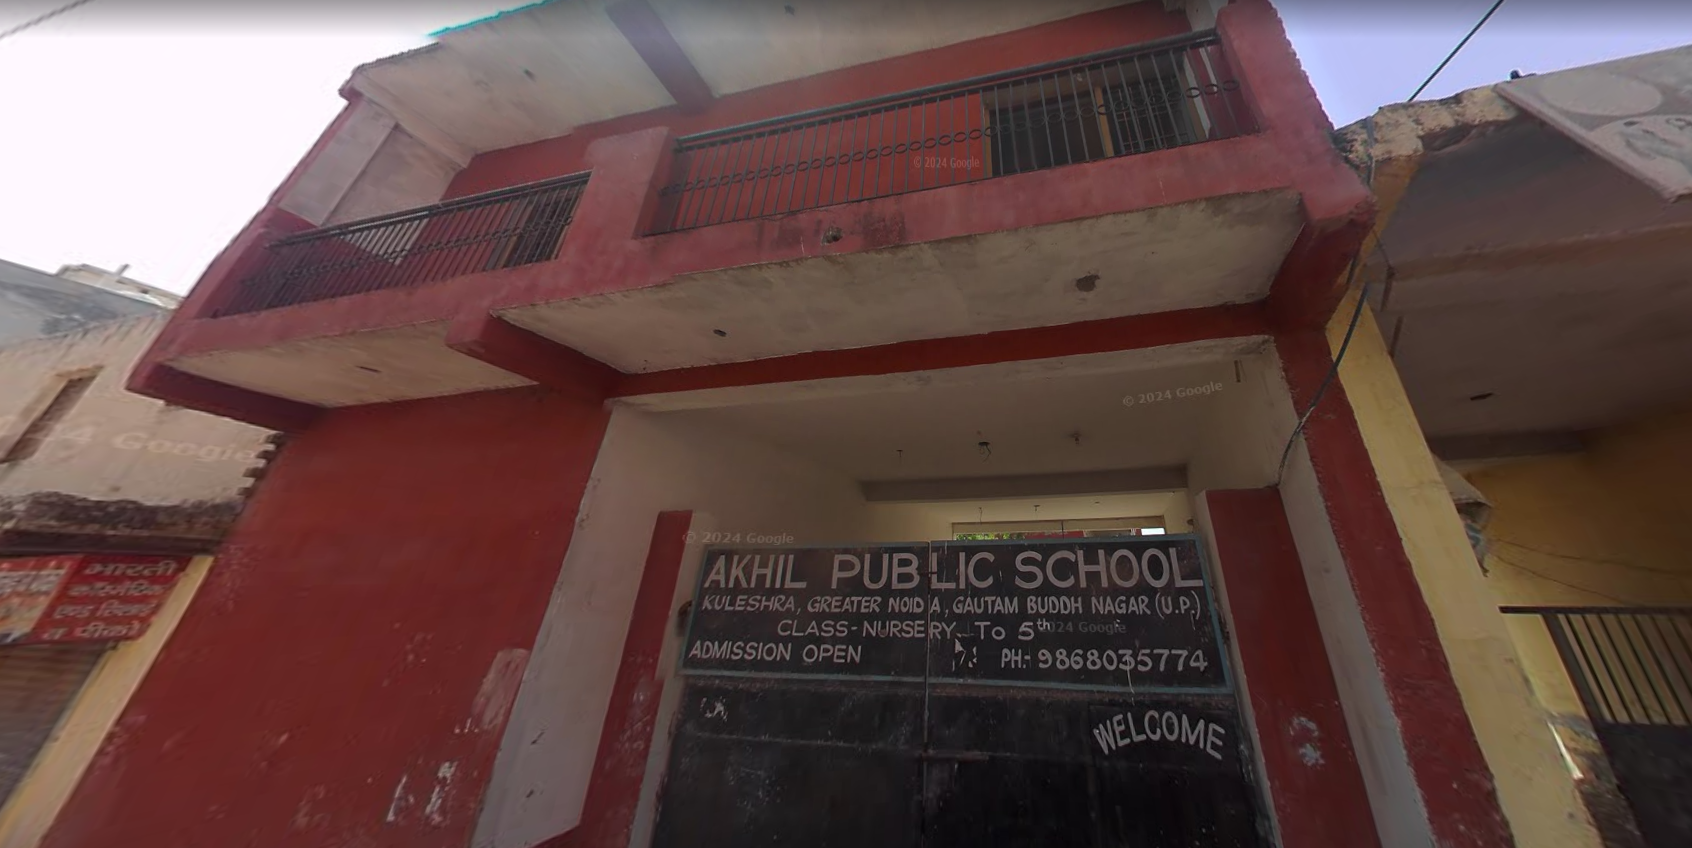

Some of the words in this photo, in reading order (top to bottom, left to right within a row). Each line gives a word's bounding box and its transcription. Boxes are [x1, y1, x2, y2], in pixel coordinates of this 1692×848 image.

[704, 554, 807, 588] AKHIL
[831, 552, 995, 590] PUBLIC
[1014, 548, 1203, 590] SCHOOL
[702, 595, 801, 615] KULESHRA,
[807, 596, 881, 613] GREATER
[952, 597, 1019, 614] GAUTAM
[1027, 597, 1083, 614] BUDDH
[1091, 596, 1151, 614] NAGAR
[688, 640, 792, 661] ADMISSION
[802, 644, 862, 664] OPEN
[1038, 648, 1208, 672] 9868035774
[1093, 709, 1226, 761] WELCOME
